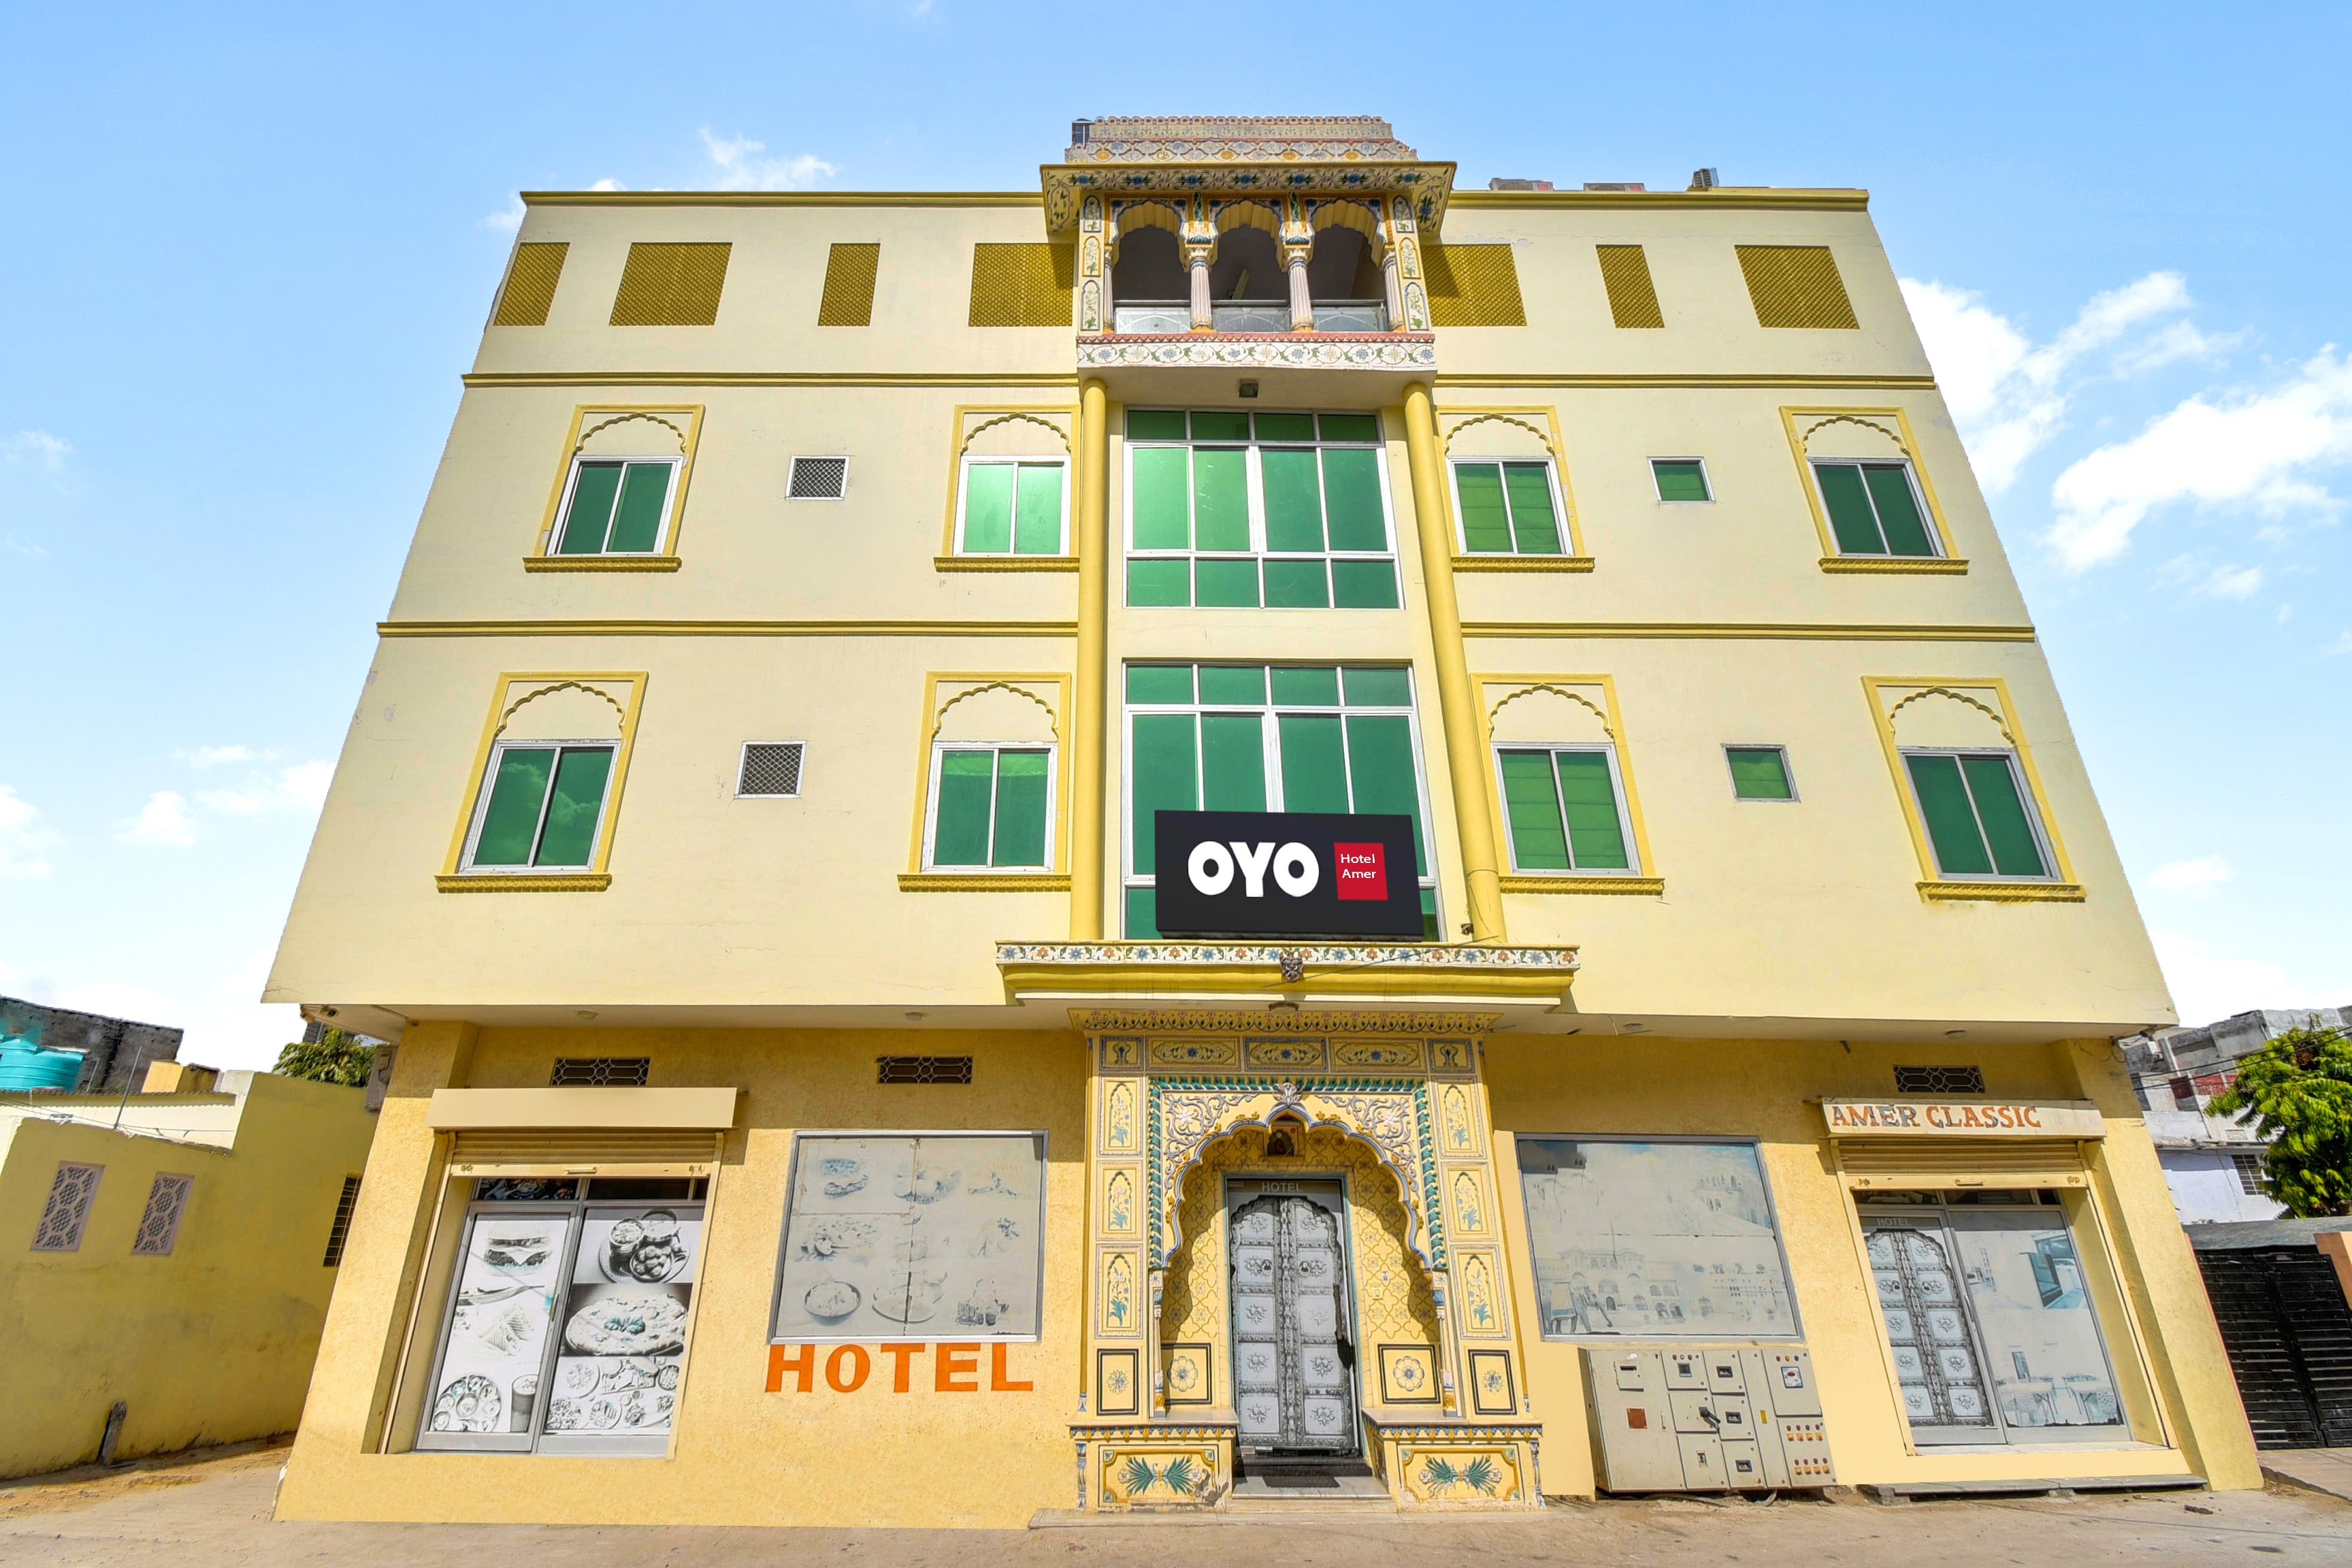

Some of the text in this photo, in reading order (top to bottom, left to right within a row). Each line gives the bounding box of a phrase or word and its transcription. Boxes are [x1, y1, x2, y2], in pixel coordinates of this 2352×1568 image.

[1341, 853, 1375, 864] Hotel
[1188, 841, 1320, 898] OYO
[1342, 869, 1377, 879] Amer
[1831, 1105, 2042, 1128] AMER CLASSIC
[1261, 1181, 1303, 1192] HOTEL
[1876, 1218, 1911, 1226] HOTEL
[765, 1343, 1033, 1393] HOTEL
